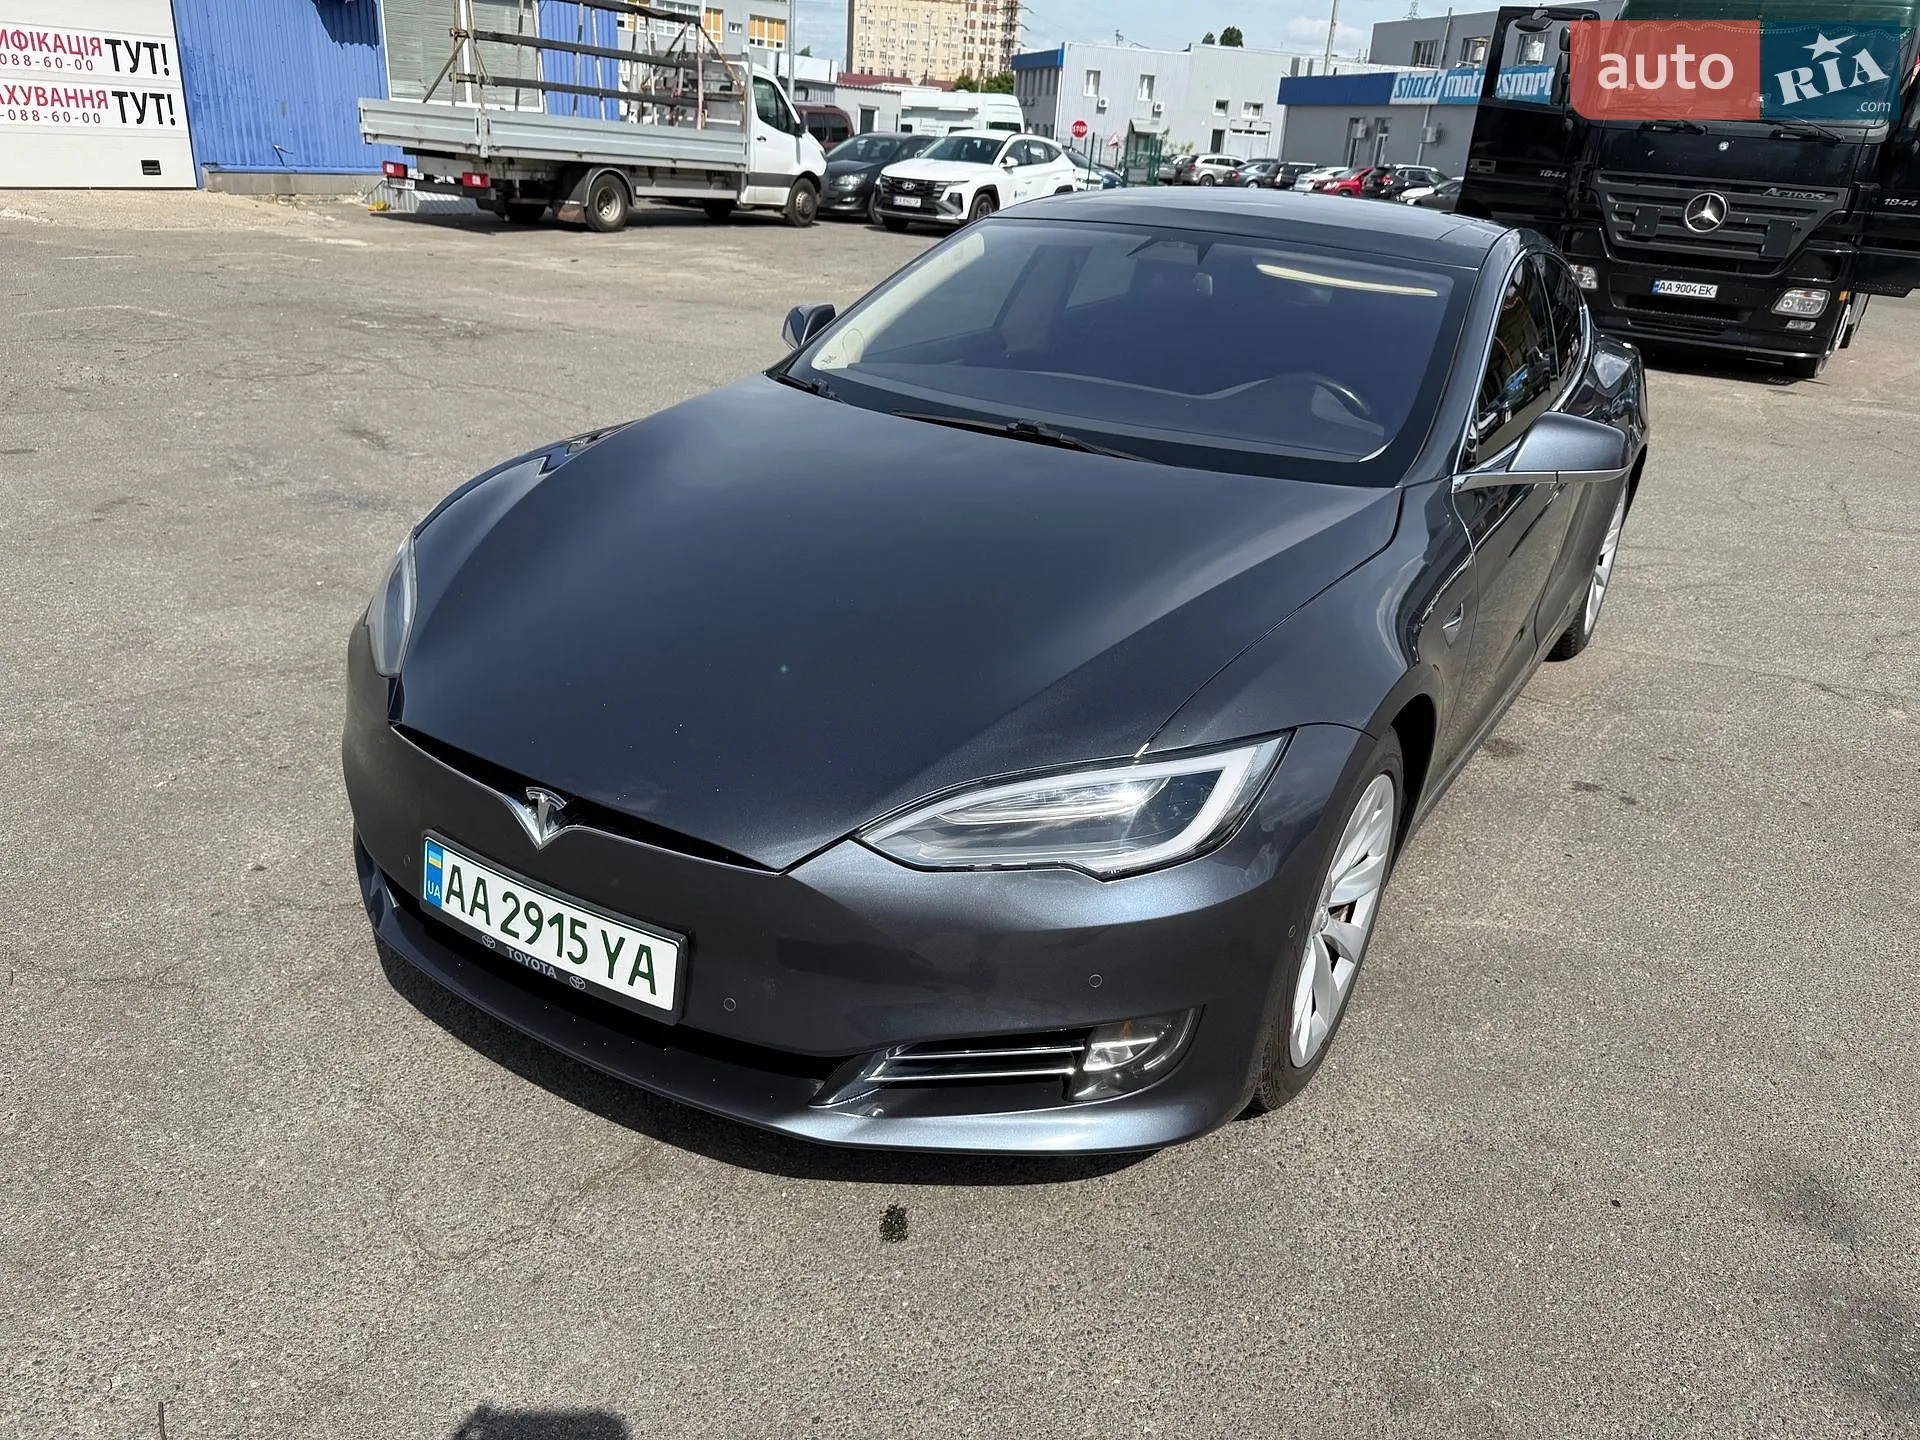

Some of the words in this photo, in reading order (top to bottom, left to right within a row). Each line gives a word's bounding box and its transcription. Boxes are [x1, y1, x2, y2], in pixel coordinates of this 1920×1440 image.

[104, 38, 170, 76] ТУТ!
[1393, 70, 1442, 99] shock
[111, 90, 176, 126] ТУТ!
[1884, 198, 1919, 207] 1844
[1660, 282, 1673, 292] AA
[1675, 283, 1697, 295] 9004
[1698, 285, 1714, 296] EK
[427, 879, 441, 899] UA
[445, 864, 491, 926] AA
[500, 891, 588, 965] 2915
[601, 929, 657, 995] YA
[506, 946, 557, 979] TOYOTA
